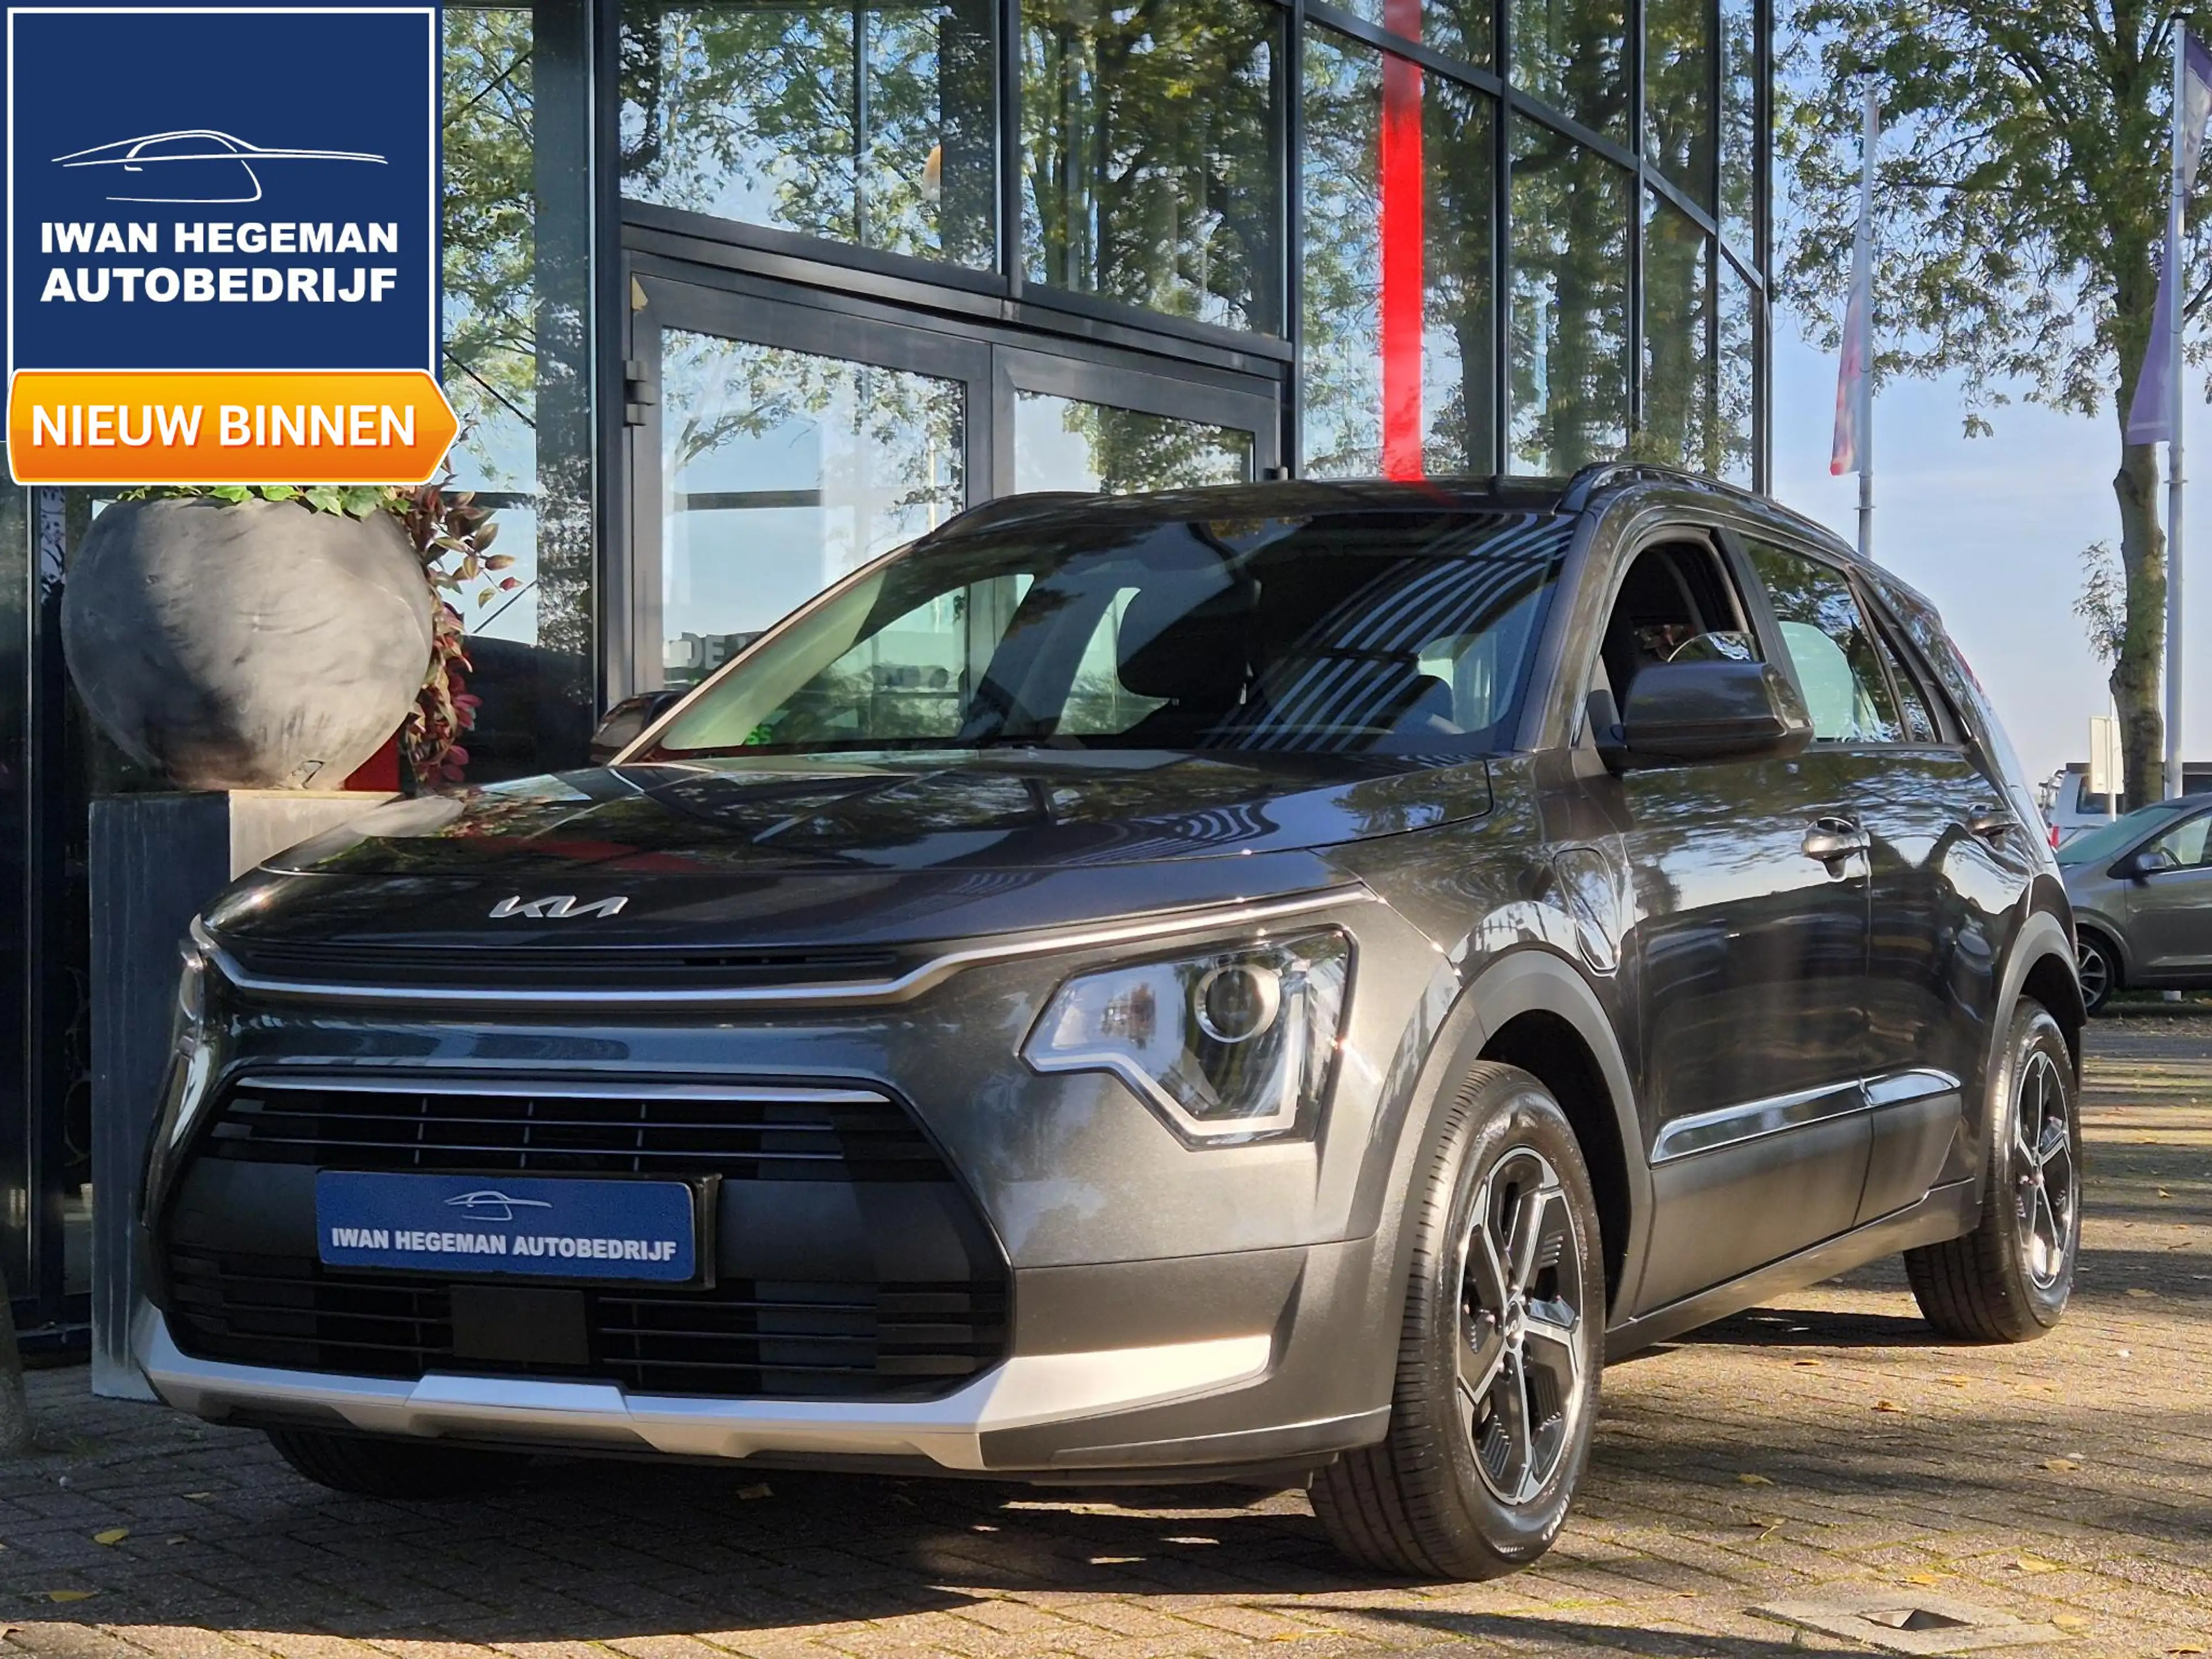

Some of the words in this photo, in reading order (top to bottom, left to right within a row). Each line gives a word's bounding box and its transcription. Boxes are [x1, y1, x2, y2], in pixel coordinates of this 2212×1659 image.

[489, 895, 628, 918] KIA
[332, 1228, 388, 1249] IWAN
[395, 1230, 506, 1255] HEGEMAN
[512, 1235, 676, 1261] AUTOBEDRIJF
